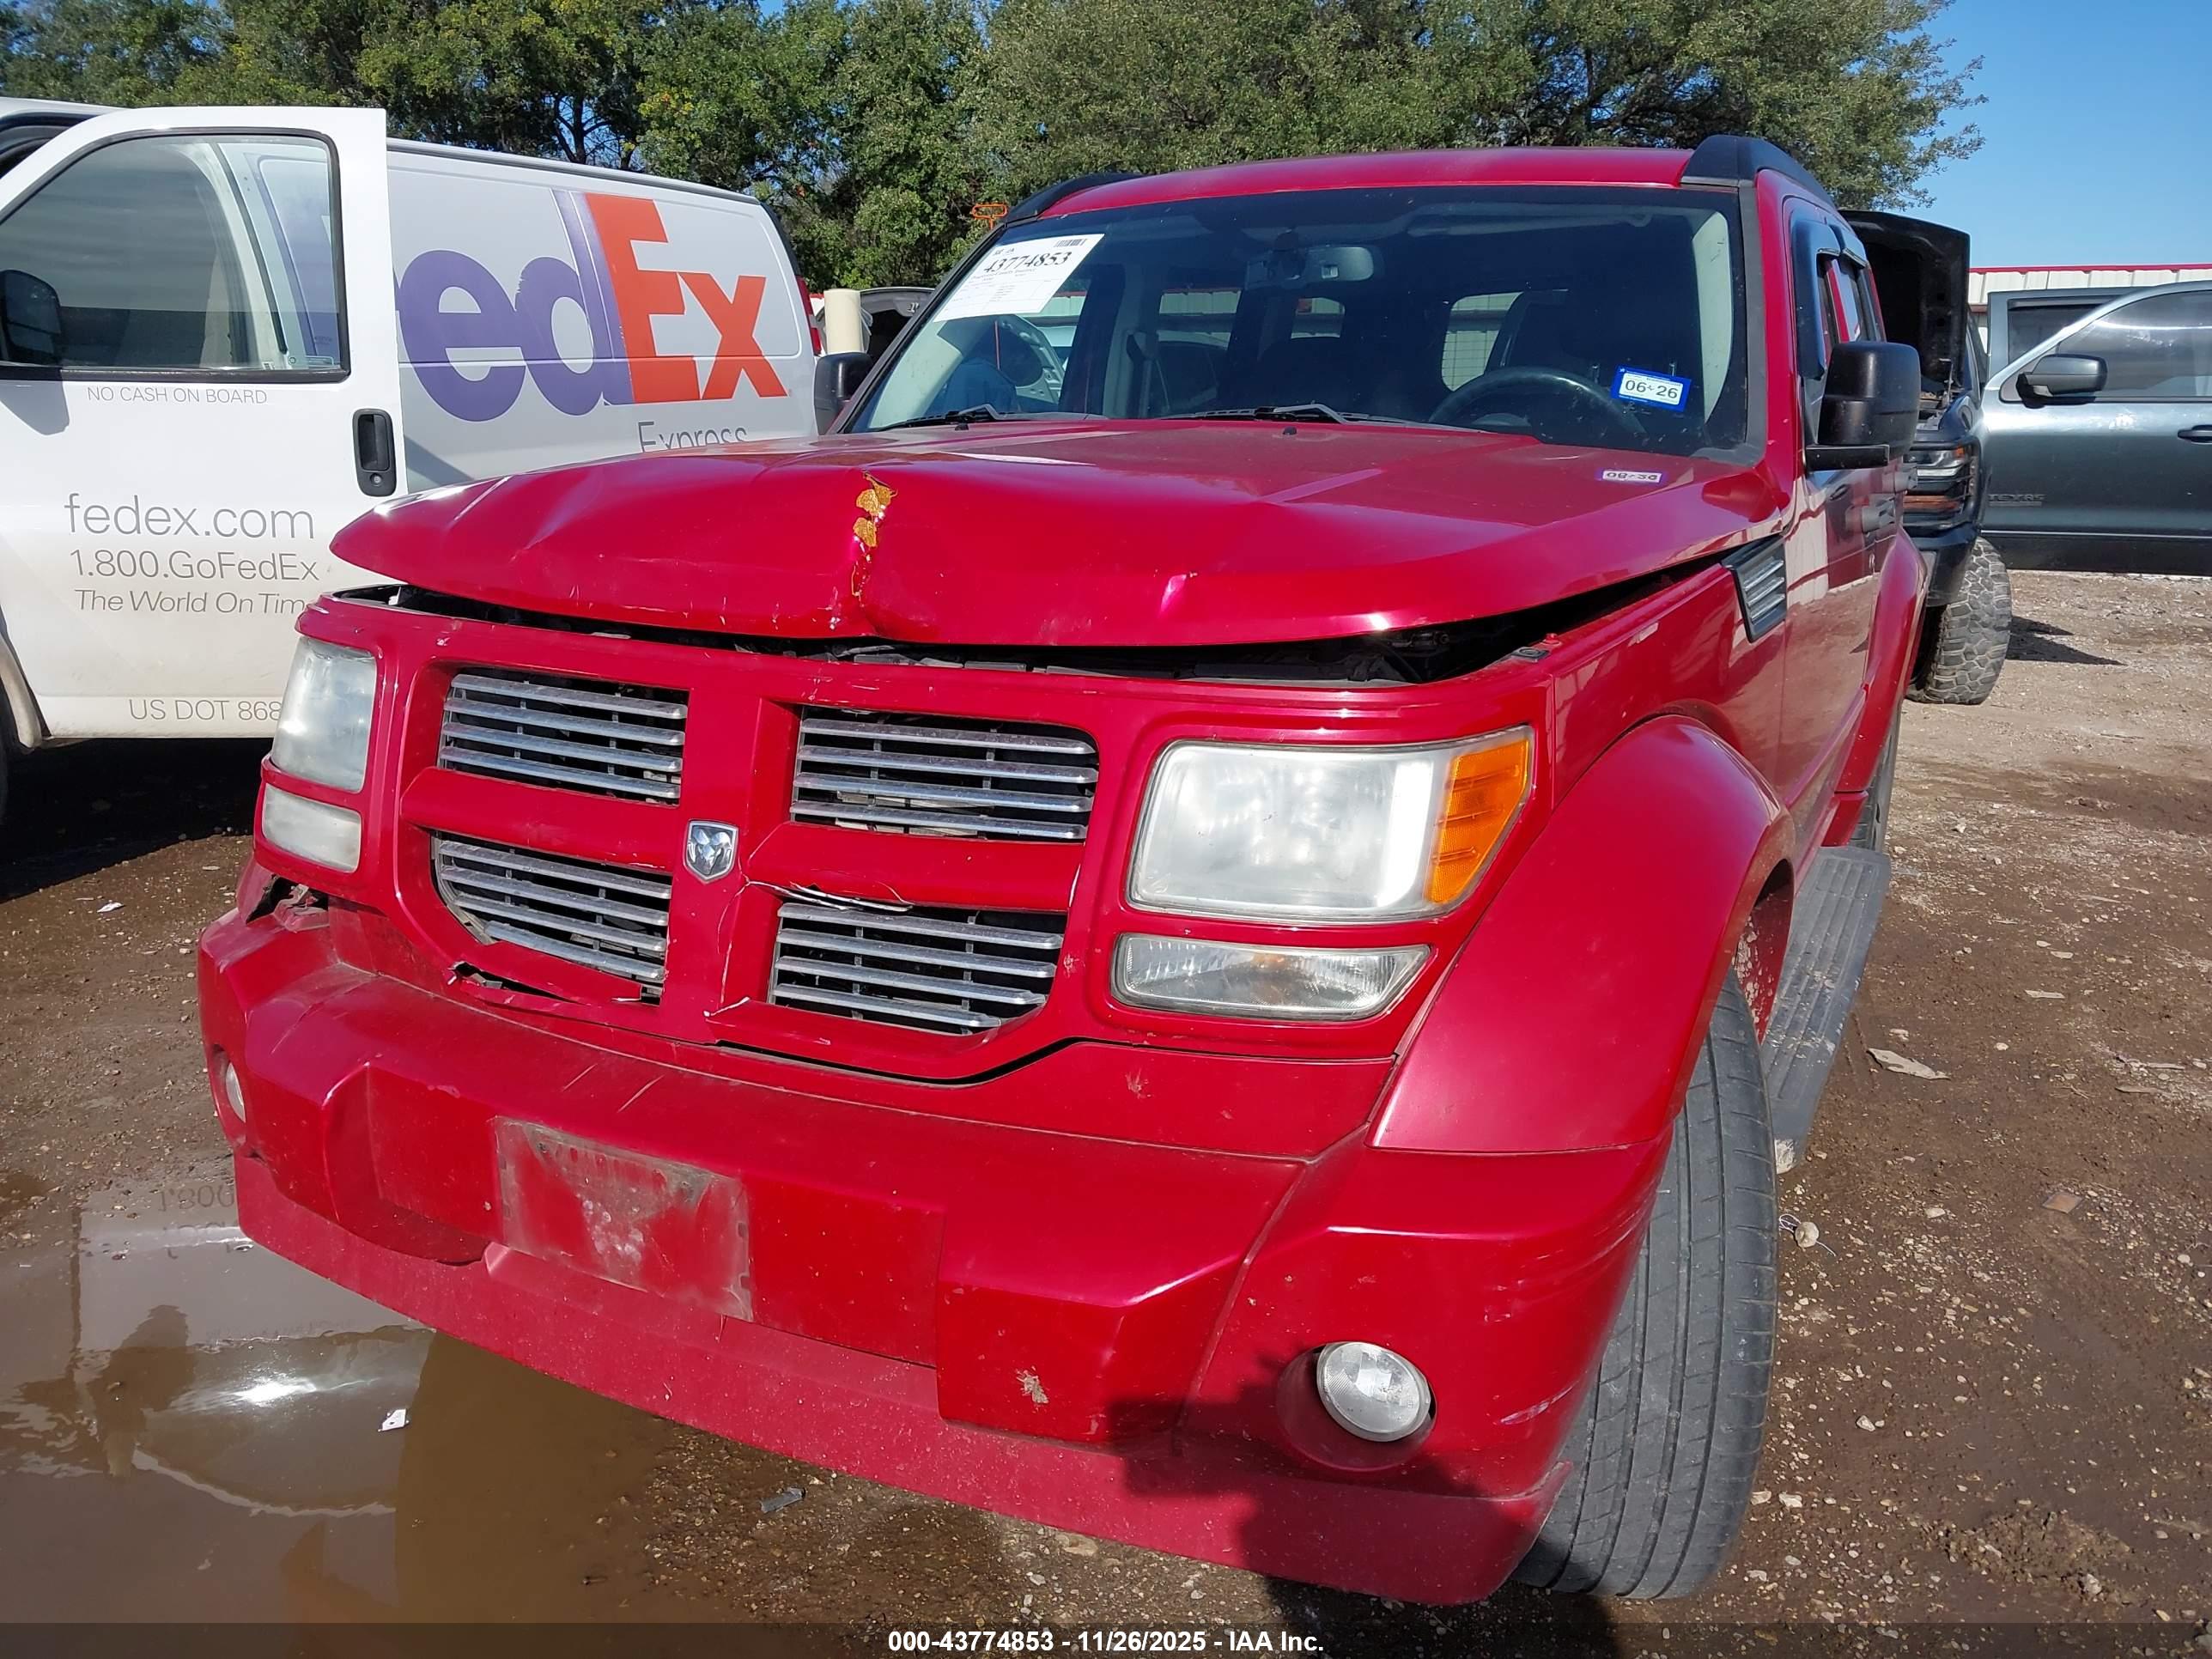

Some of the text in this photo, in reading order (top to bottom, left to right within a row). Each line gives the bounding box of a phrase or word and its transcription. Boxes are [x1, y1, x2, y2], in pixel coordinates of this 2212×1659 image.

[983, 251, 1073, 274] 43774853
[392, 189, 788, 422] edEx
[87, 386, 268, 404] NO CASH ON BOARD
[64, 492, 314, 539] fedex.com
[70, 549, 319, 581] 1.800.GoFedEx
[74, 589, 306, 615] The World On Tim
[129, 698, 282, 721] US DOT 868
